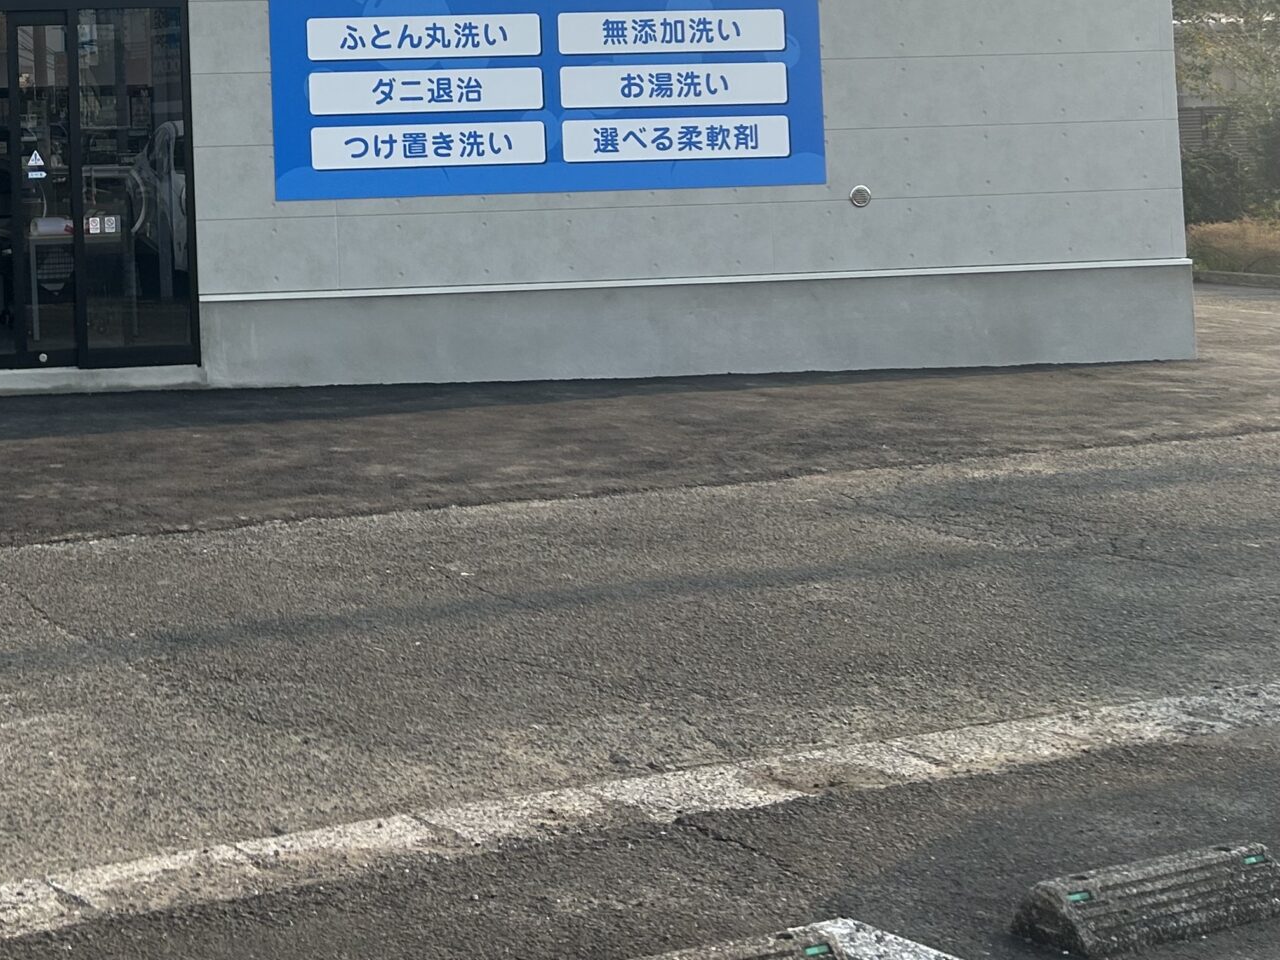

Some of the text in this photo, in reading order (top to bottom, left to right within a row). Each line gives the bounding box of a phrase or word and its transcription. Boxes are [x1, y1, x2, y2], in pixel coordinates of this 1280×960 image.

[339, 23, 509, 50] ふとん丸洗い
[601, 17, 742, 45] 無添加洗い
[371, 76, 484, 105] ダニ退治
[619, 71, 730, 99] お湯洗い
[343, 130, 514, 159] つけ置き洗い
[593, 124, 760, 152] 選べる柔軟剤
